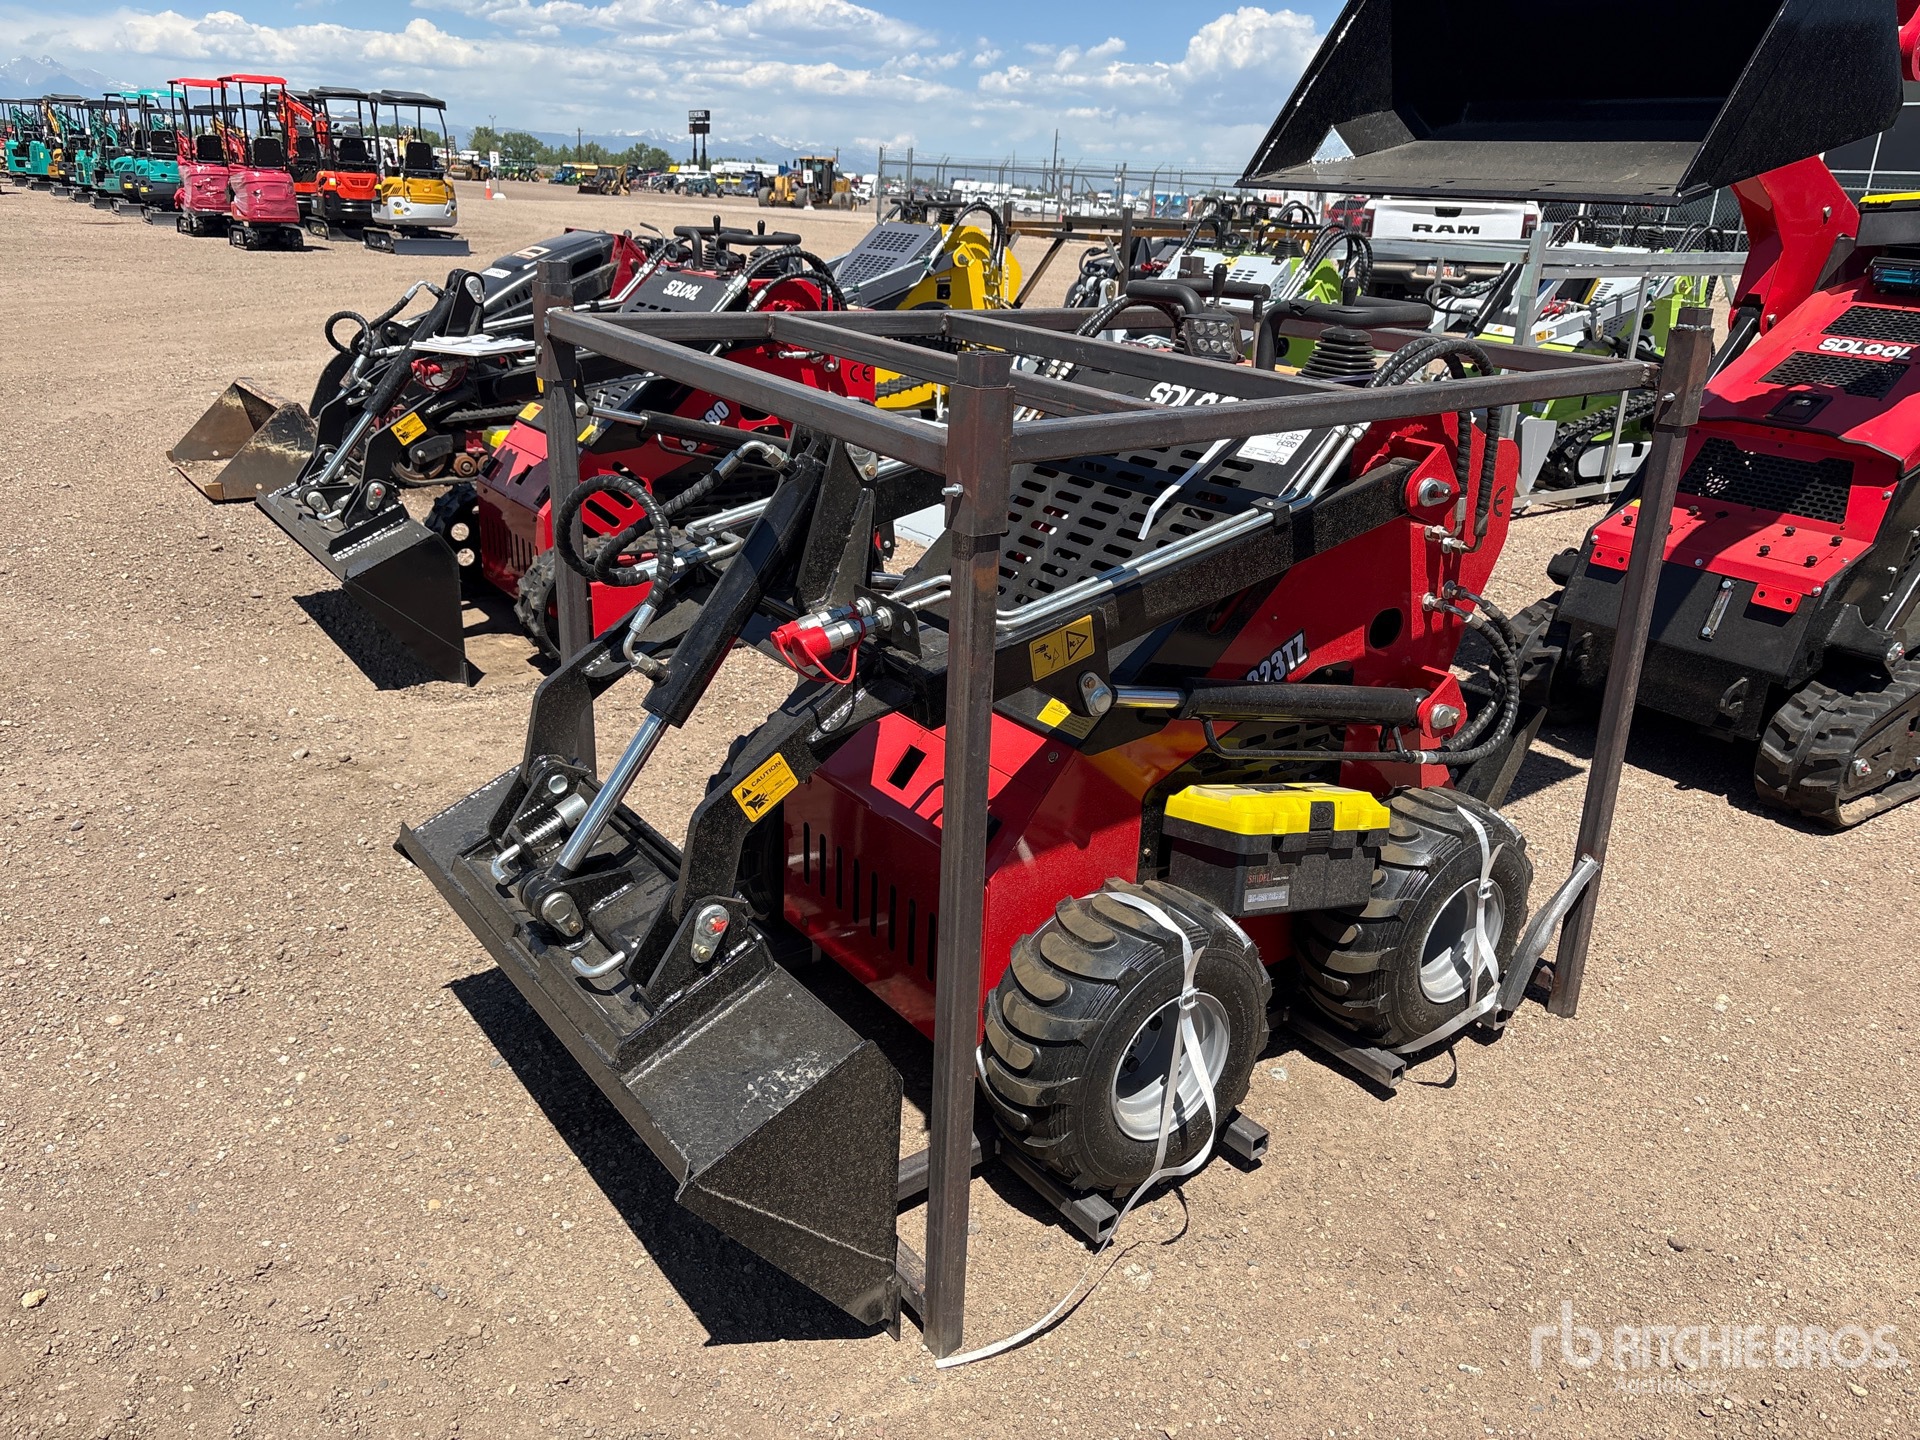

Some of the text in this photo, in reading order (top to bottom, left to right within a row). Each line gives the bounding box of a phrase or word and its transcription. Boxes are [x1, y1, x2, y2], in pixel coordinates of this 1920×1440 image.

[1412, 223, 1480, 235] RAM
[1818, 337, 1912, 360] SDLOOL
[751, 760, 782, 787] CAUTION
